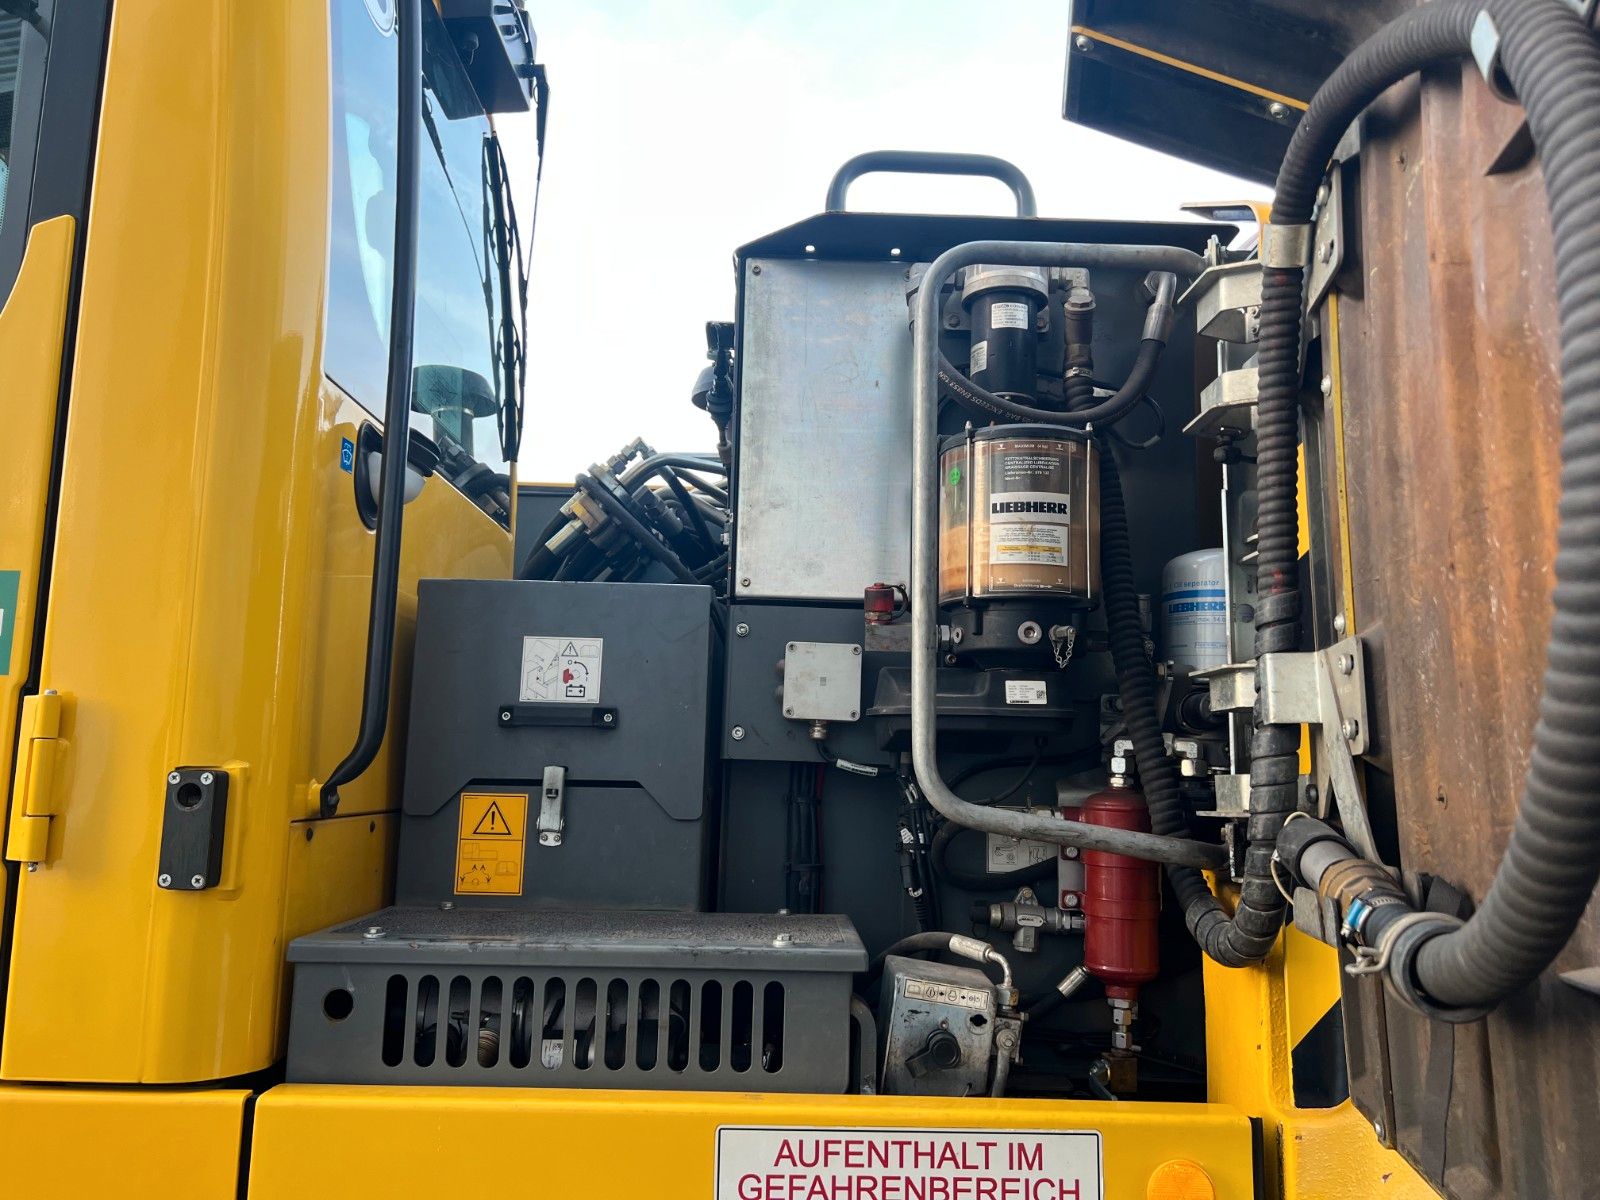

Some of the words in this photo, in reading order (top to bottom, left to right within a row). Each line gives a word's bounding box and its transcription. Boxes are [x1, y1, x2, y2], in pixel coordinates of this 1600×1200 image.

[991, 501, 1068, 515] LIEBHERR
[773, 1139, 997, 1171] AUFENTHALT
[1008, 1143, 1043, 1171] IM
[738, 1174, 1080, 1200] GEFAHRENBEREICH
